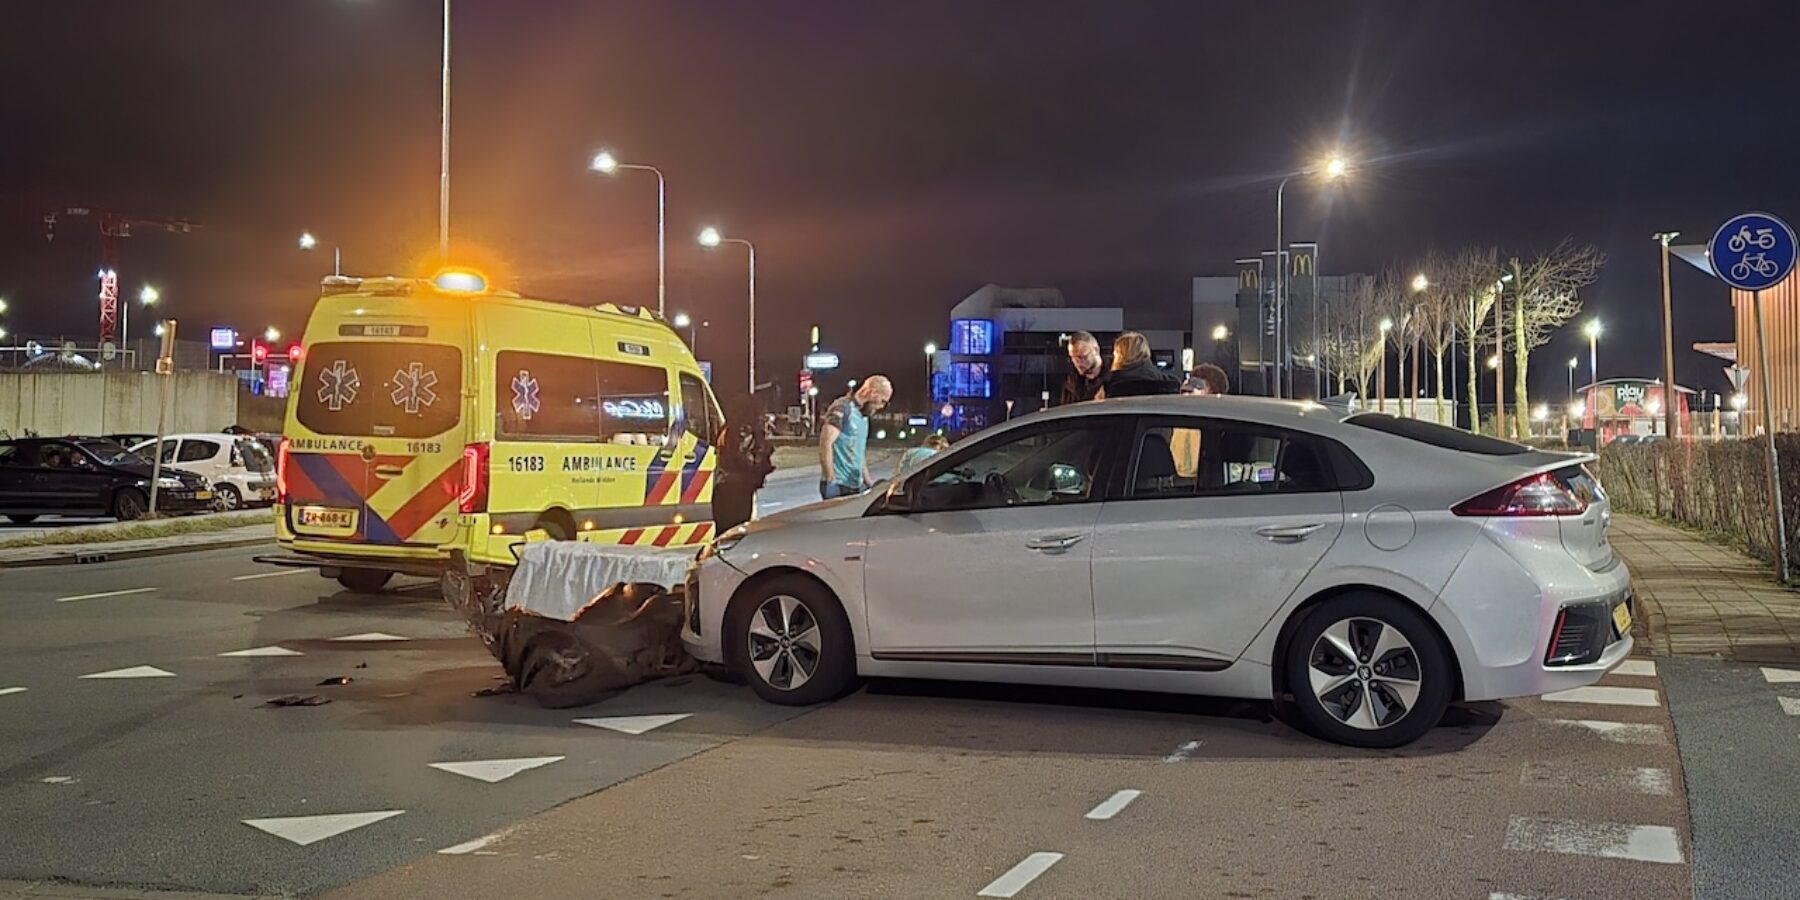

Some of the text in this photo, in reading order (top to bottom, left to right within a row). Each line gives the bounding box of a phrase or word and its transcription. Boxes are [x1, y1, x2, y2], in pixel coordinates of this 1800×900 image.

[1617, 384, 1645, 400] play
[288, 438, 364, 451] AMBULANCE
[406, 442, 441, 453] 16183
[508, 456, 544, 471] 16183
[562, 456, 637, 471] AMBULANCE
